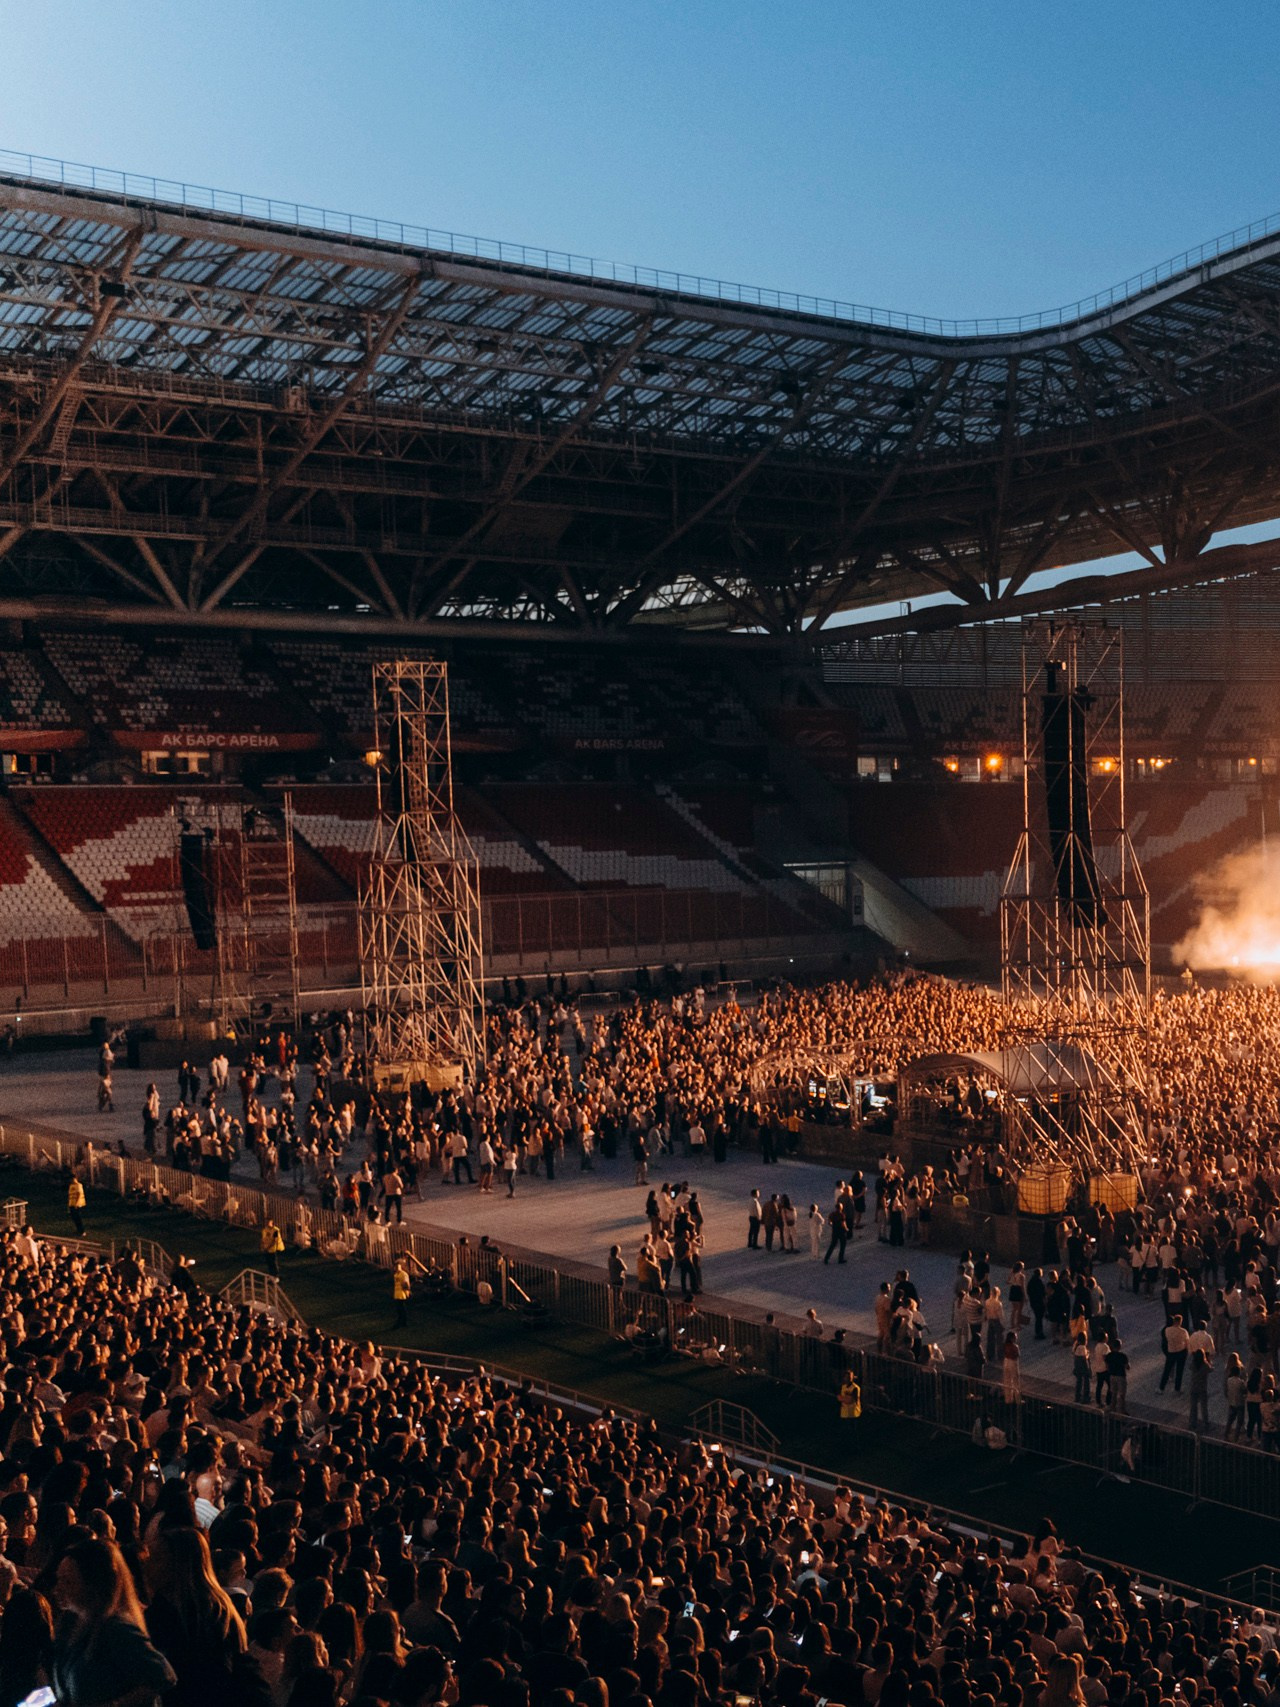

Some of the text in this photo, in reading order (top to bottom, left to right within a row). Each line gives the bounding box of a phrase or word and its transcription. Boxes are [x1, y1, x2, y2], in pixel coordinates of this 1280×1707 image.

[162, 735, 280, 747] АК БАРС АРЕНА
[575, 739, 665, 750] AK BARS ARENA
